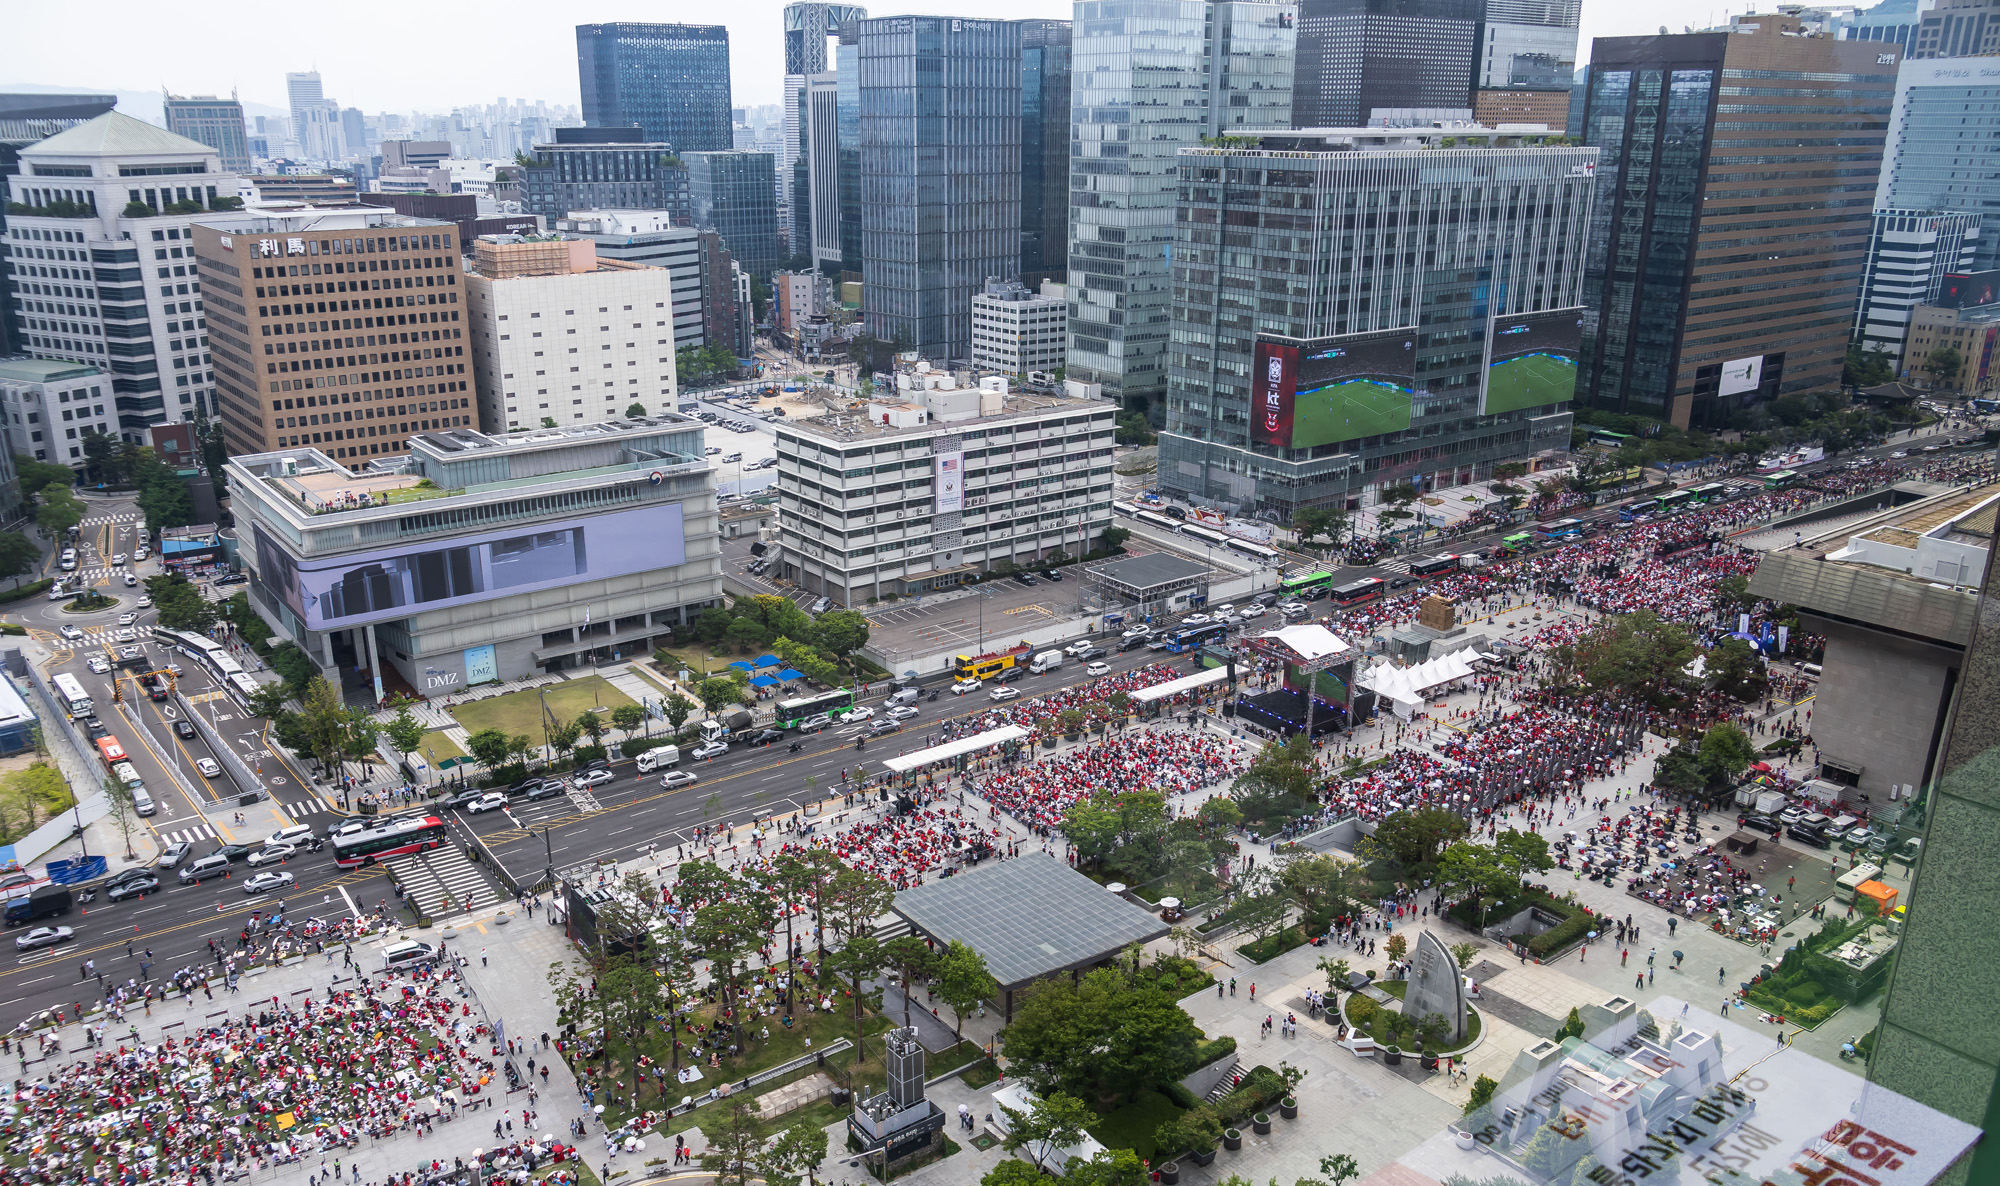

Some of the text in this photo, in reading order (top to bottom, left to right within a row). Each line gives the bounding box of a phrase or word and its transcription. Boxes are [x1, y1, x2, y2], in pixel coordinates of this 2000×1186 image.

[1279, 13, 1293, 28] kt
[1583, 162, 1595, 177] kt
[259, 237, 305, 256] 利馬
[1267, 391, 1280, 405] kt
[472, 666, 491, 677] DMZ
[427, 672, 459, 689] DMZ
